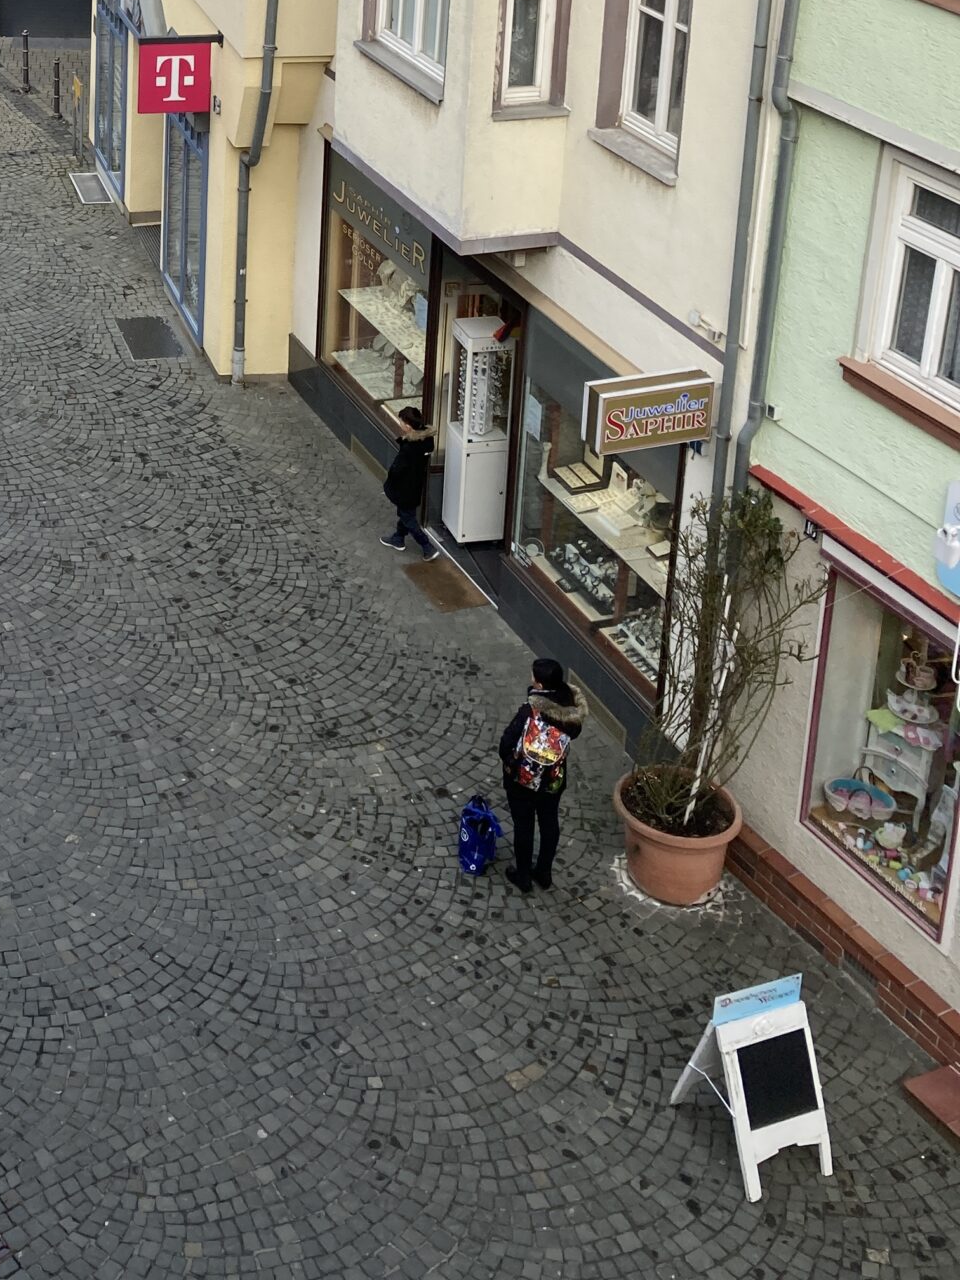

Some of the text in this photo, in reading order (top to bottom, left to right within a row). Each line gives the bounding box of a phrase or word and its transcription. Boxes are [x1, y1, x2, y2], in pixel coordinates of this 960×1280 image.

[155, 55, 195, 102] T
[604, 407, 707, 443] SAPHIR
[624, 393, 709, 423] Juwelier
